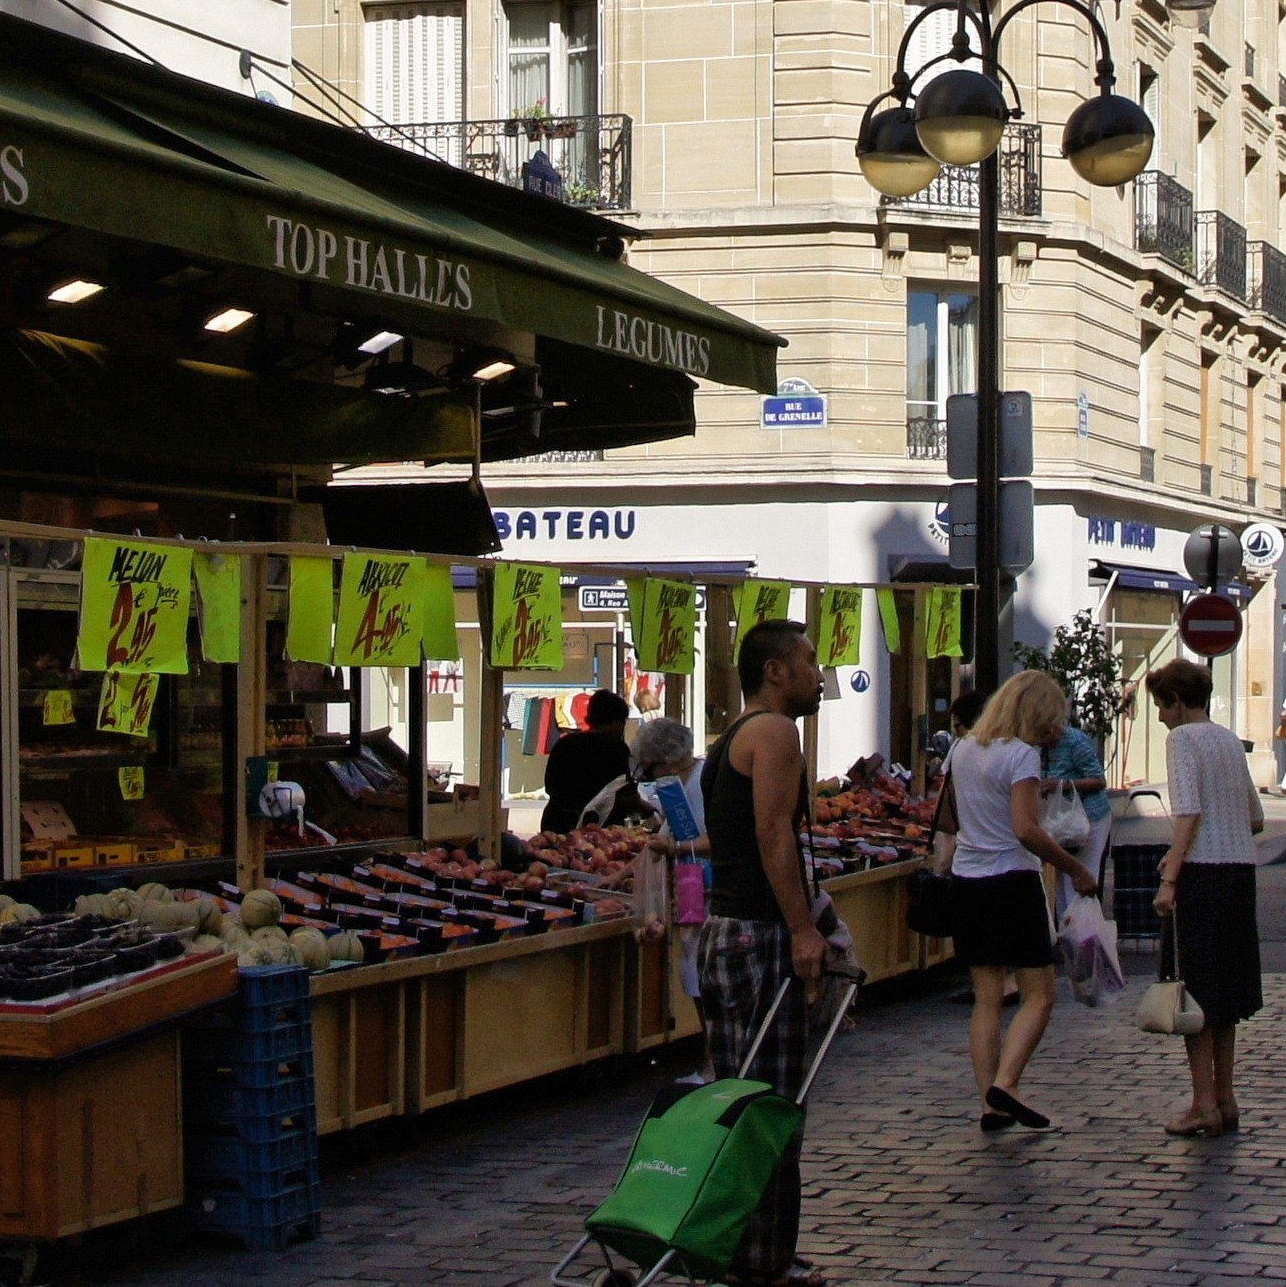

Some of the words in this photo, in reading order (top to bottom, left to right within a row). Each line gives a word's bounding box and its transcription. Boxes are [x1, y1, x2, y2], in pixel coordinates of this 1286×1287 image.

[266, 215, 338, 280] TOP
[343, 235, 473, 311] HALLES
[596, 305, 711, 375] LEGUMES
[764, 413, 777, 422] DE
[778, 411, 823, 422] GRENELLE
[784, 402, 803, 411] RUE
[495, 510, 636, 541] BATEAU
[108, 546, 168, 582] MELON
[357, 560, 411, 596] ABRICOT
[599, 590, 626, 599] Maison
